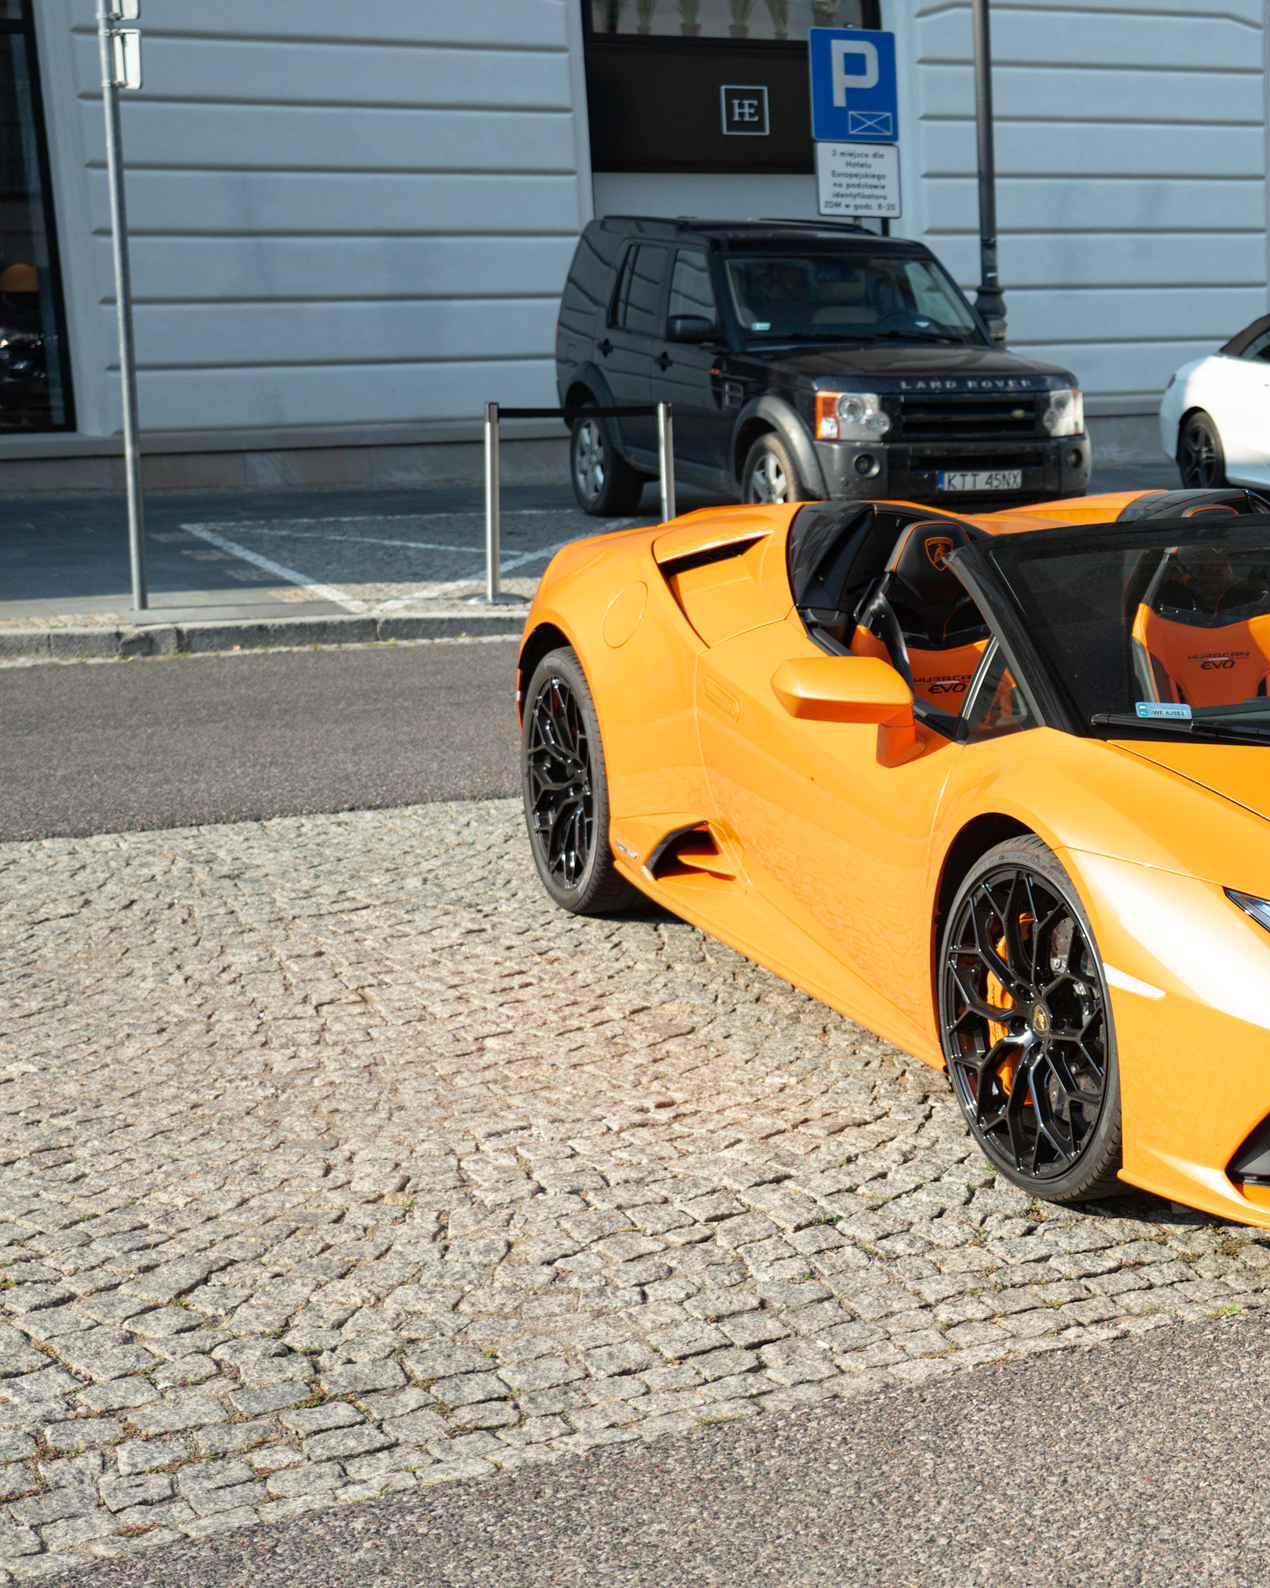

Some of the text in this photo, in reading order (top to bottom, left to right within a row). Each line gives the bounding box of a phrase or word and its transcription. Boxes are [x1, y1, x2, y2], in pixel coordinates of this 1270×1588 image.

[831, 39, 879, 107] P
[831, 149, 837, 157] 3
[845, 161, 872, 169] Hotelu
[831, 170, 887, 180] Europejskiego
[846, 182, 886, 190] podstawie
[901, 379, 1032, 390] LAND ROVER
[947, 474, 979, 490] KTT
[985, 472, 1021, 489] 45NX
[1201, 660, 1235, 670] EVO
[928, 683, 967, 693] EVO
